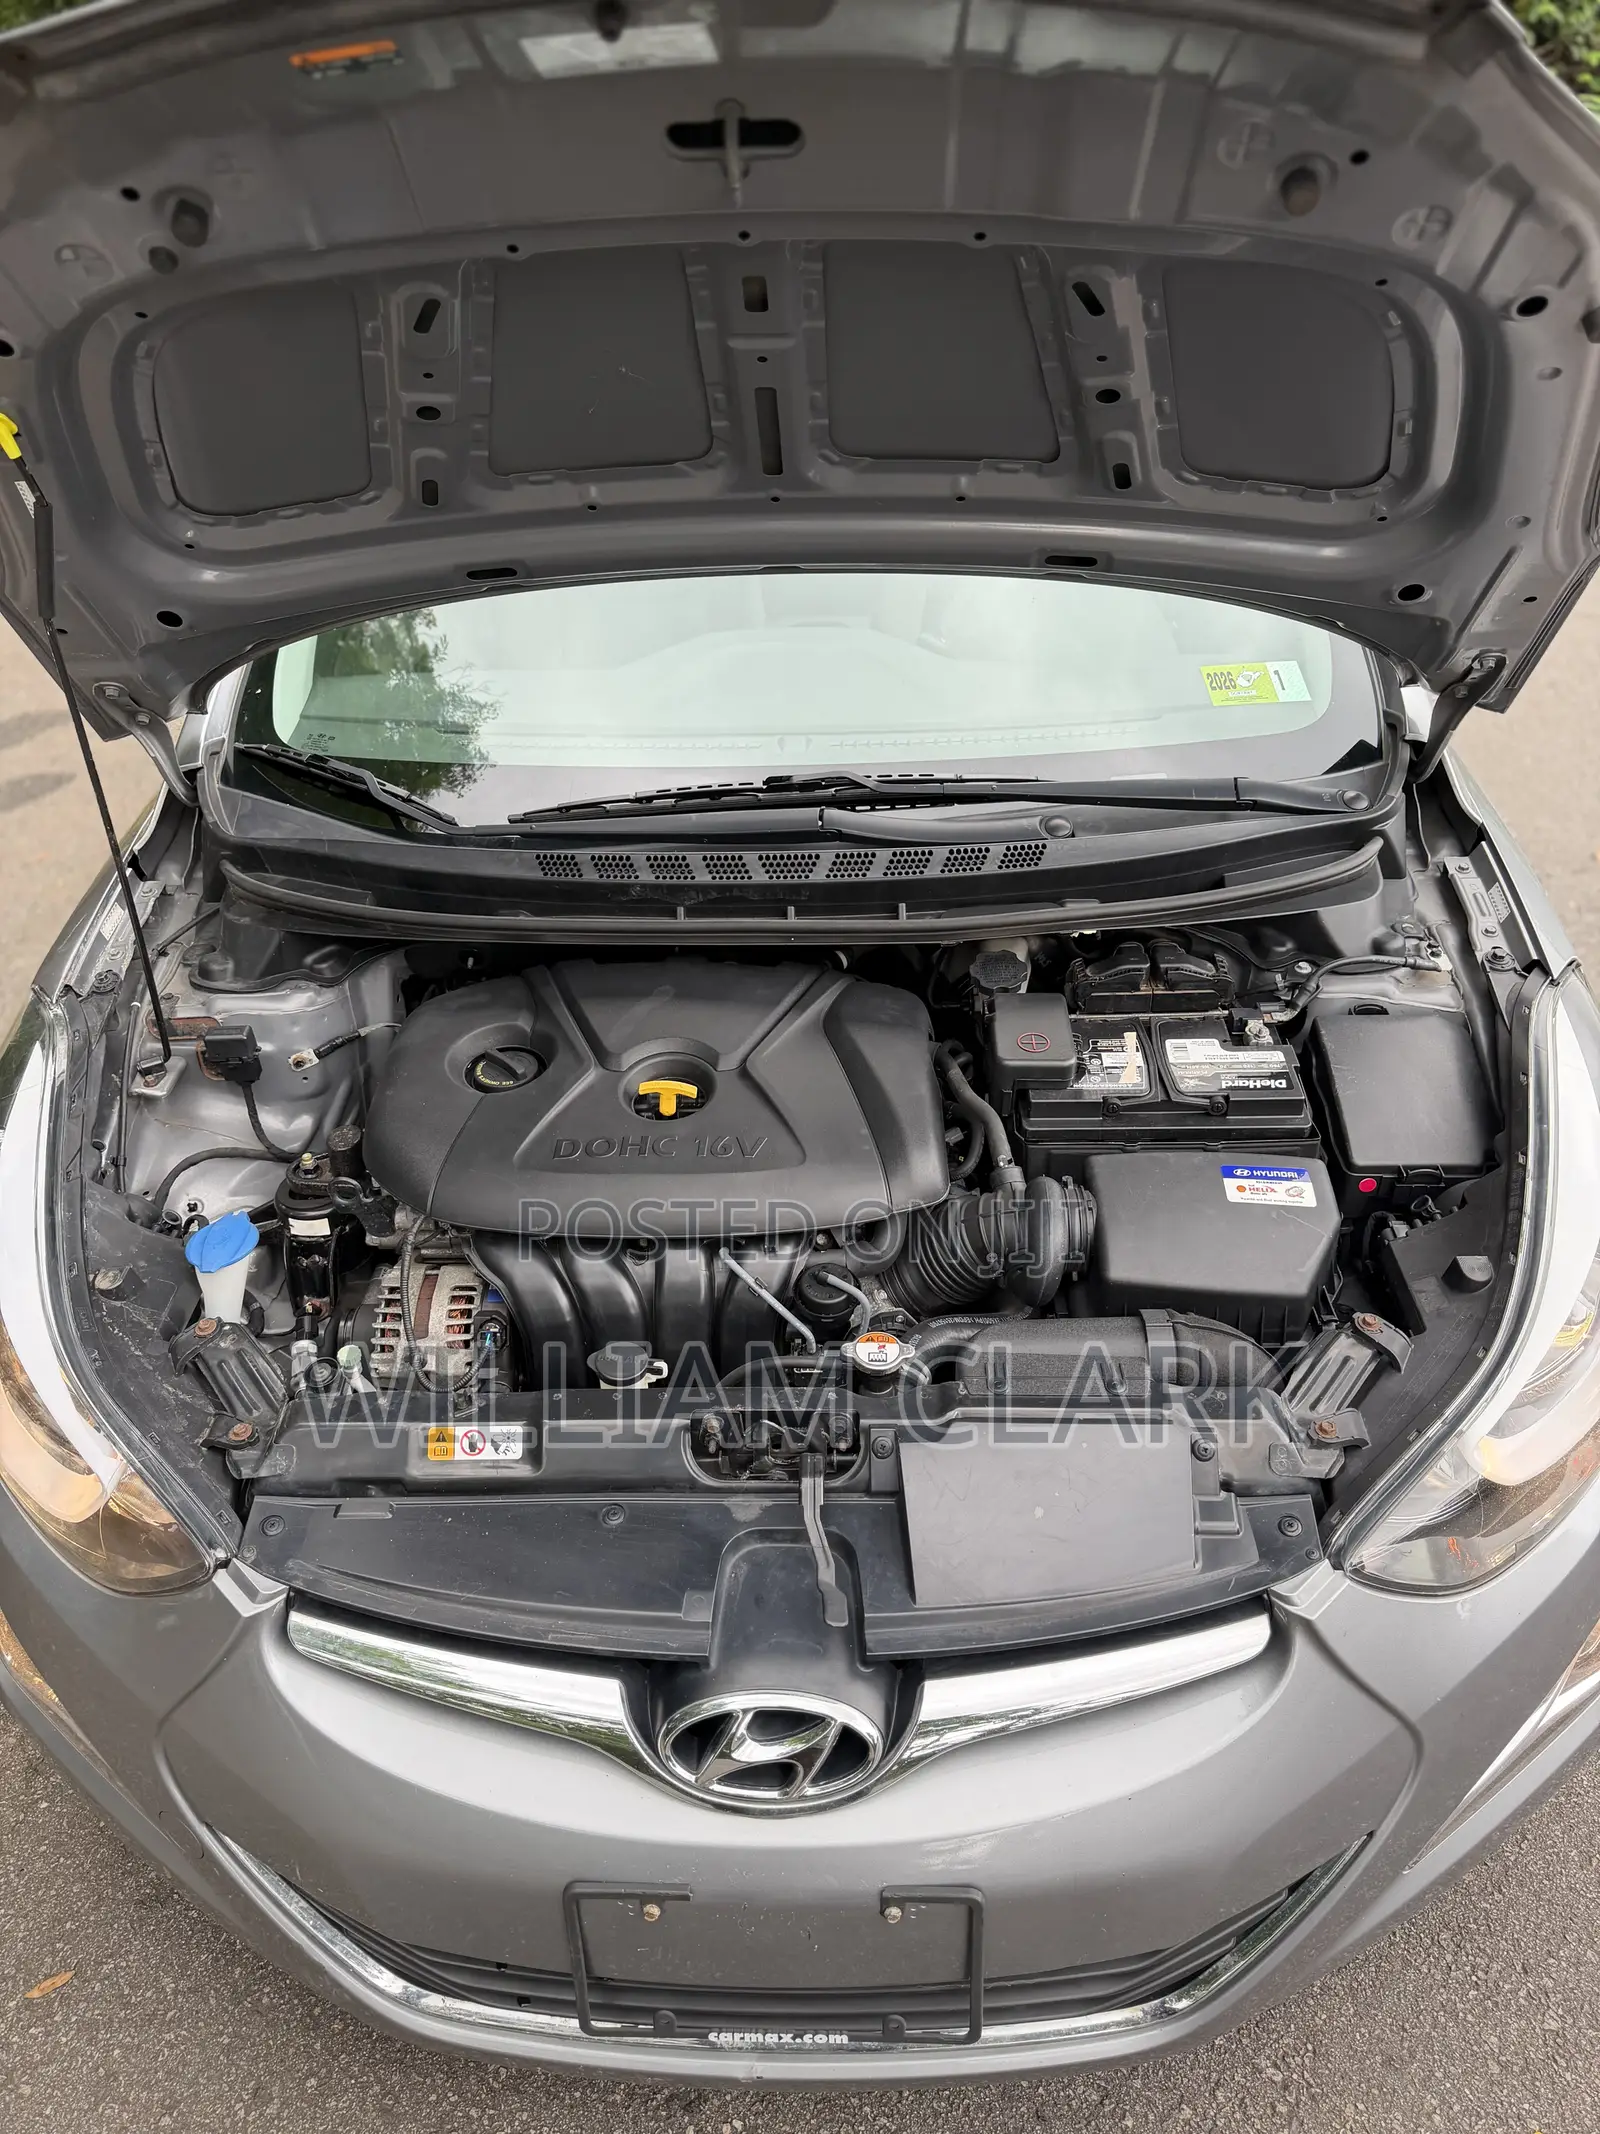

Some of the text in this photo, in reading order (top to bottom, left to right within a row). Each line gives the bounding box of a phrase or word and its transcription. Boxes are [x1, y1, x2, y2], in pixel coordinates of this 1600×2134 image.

[1206, 671, 1237, 691] 2026
[1273, 669, 1285, 691] 1
[1221, 1078, 1287, 1089] DieHard
[552, 1134, 768, 1160] DOHC 16V
[1252, 1169, 1299, 1179] HYUNDAI
[1248, 1185, 1278, 1194] HELIX
[707, 2031, 849, 2044] carmax.com
